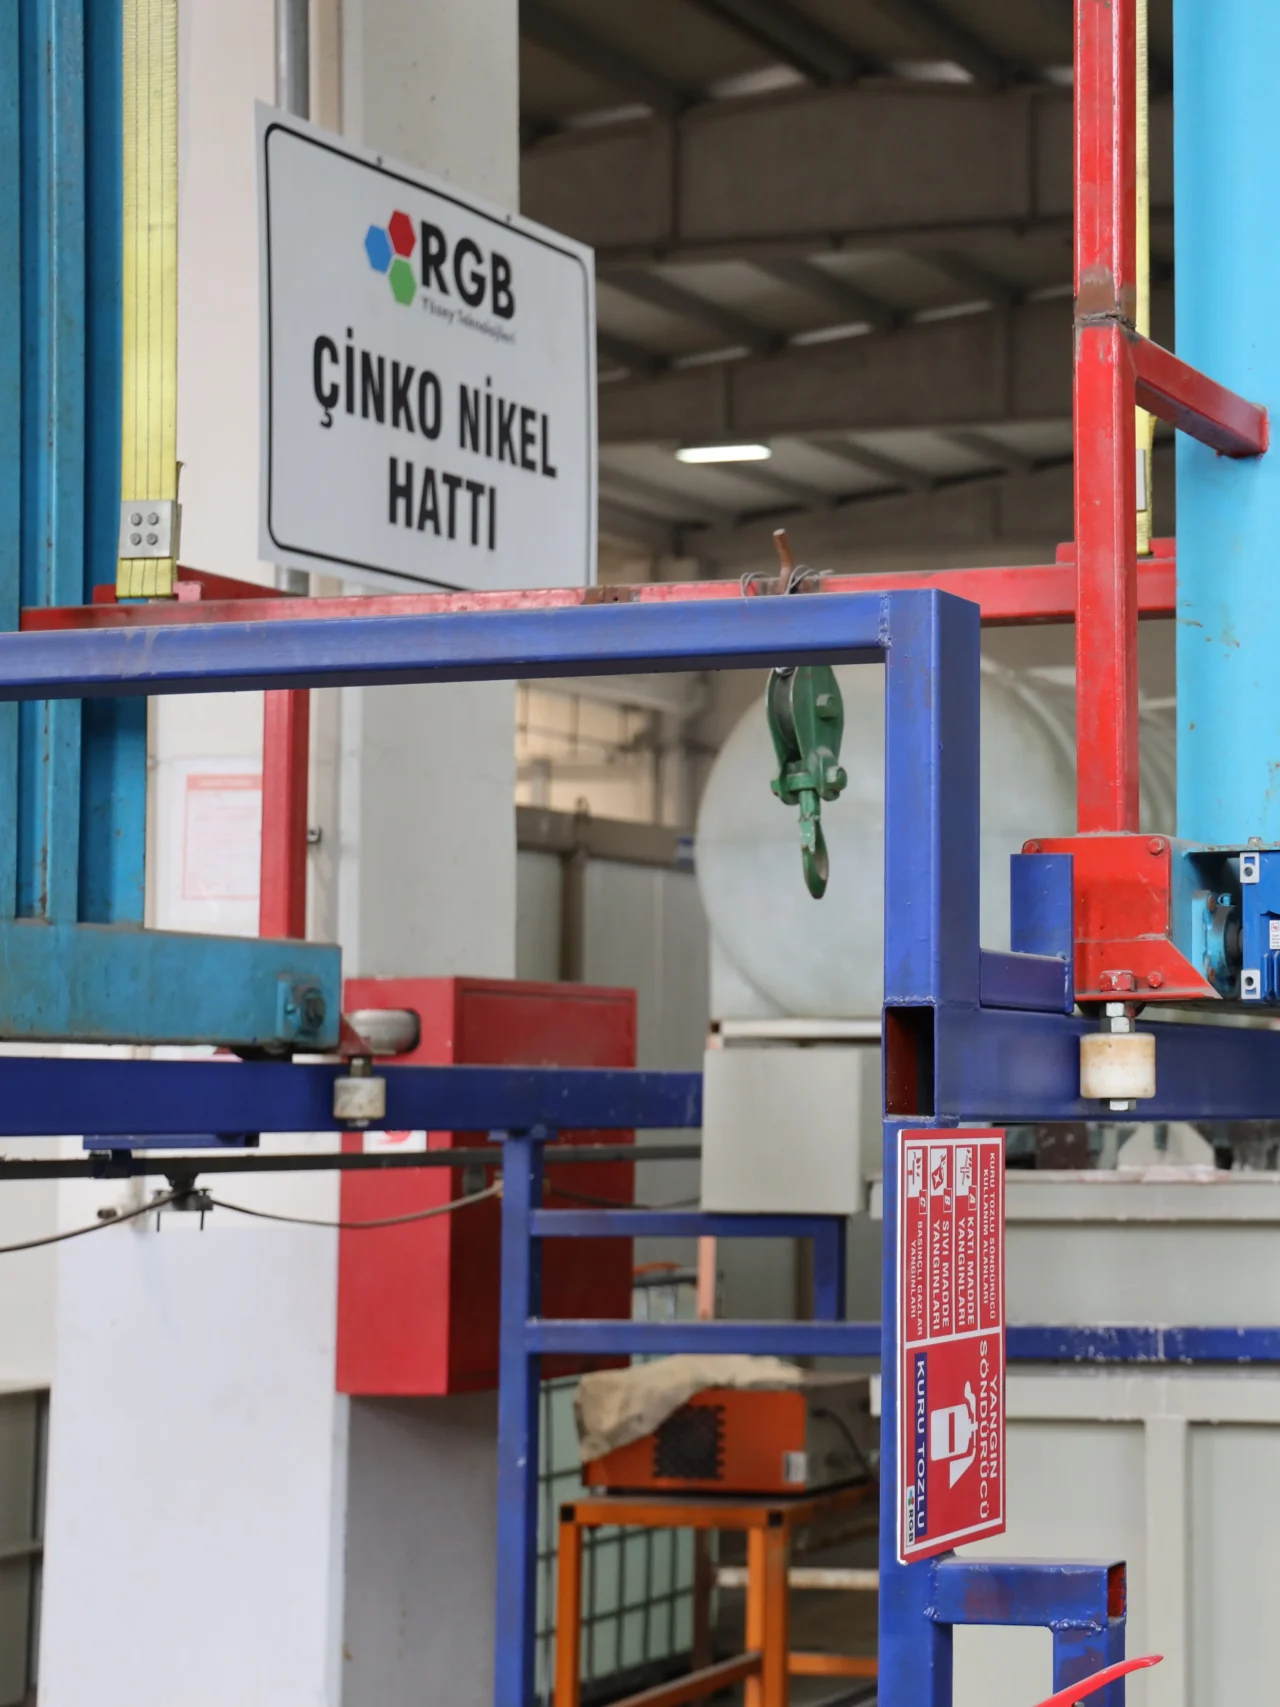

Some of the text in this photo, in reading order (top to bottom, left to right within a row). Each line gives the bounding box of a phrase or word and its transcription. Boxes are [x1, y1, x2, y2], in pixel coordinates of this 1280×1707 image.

[421, 220, 516, 320] RGB
[313, 327, 558, 478] ÇİNKO NİKEL
[388, 457, 497, 550] HATTI
[917, 1360, 925, 1528] KURU TOZLU
[979, 1341, 989, 1519] SÖNDÜRÜCÜ
